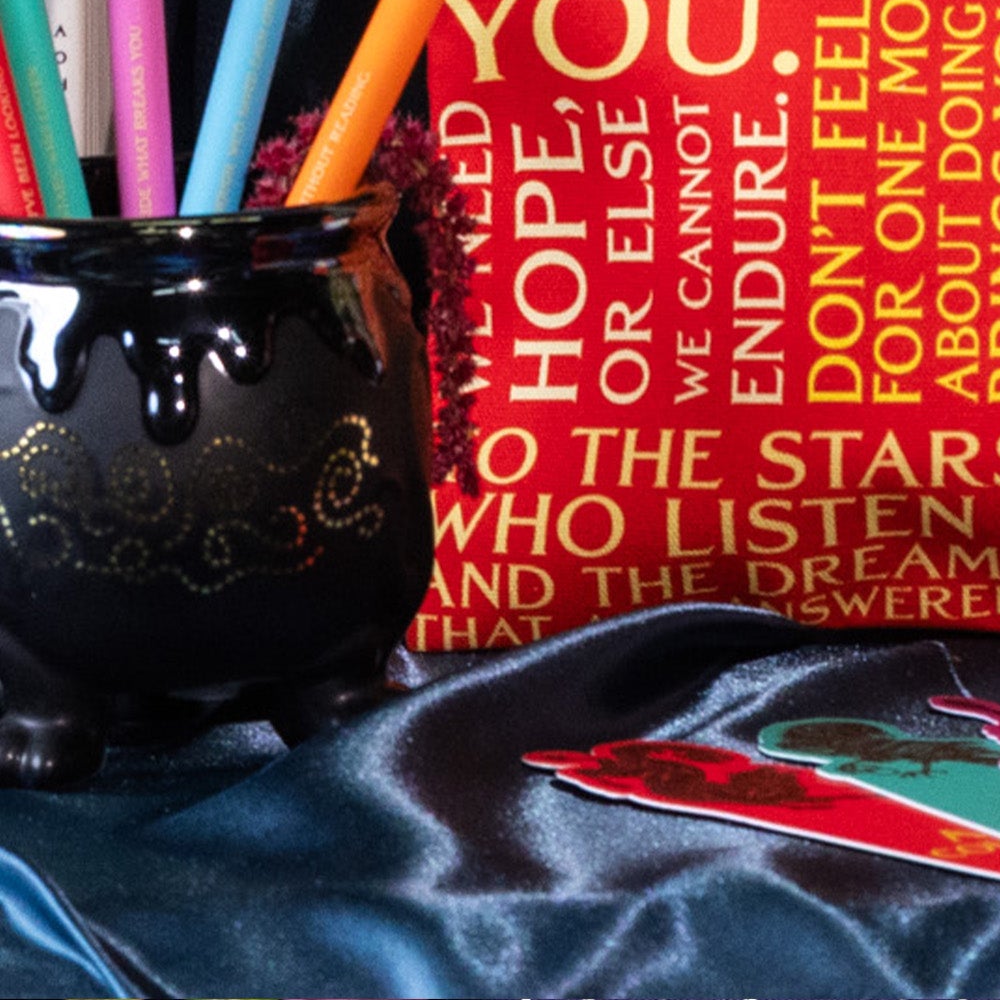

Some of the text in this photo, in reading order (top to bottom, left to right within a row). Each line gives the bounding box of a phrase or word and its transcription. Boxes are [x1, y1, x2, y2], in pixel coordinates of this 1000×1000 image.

[938, 2, 987, 182] DOING
[509, 96, 588, 403] HOPE,
[597, 95, 655, 406] OR ELSE
[673, 94, 713, 406] WE CANNOT
[730, 92, 790, 406] ENDURE.
[875, 119, 928, 252] ONE
[808, 178, 866, 404] DON'T
[872, 274, 926, 404] FOR
[934, 203, 981, 404] ABOUT
[430, 489, 626, 559] WHO
[666, 494, 976, 558] LISTEN
[570, 426, 724, 490] THE
[415, 613, 553, 652] THAT
[430, 557, 555, 611] AND
[581, 561, 719, 609] THE
